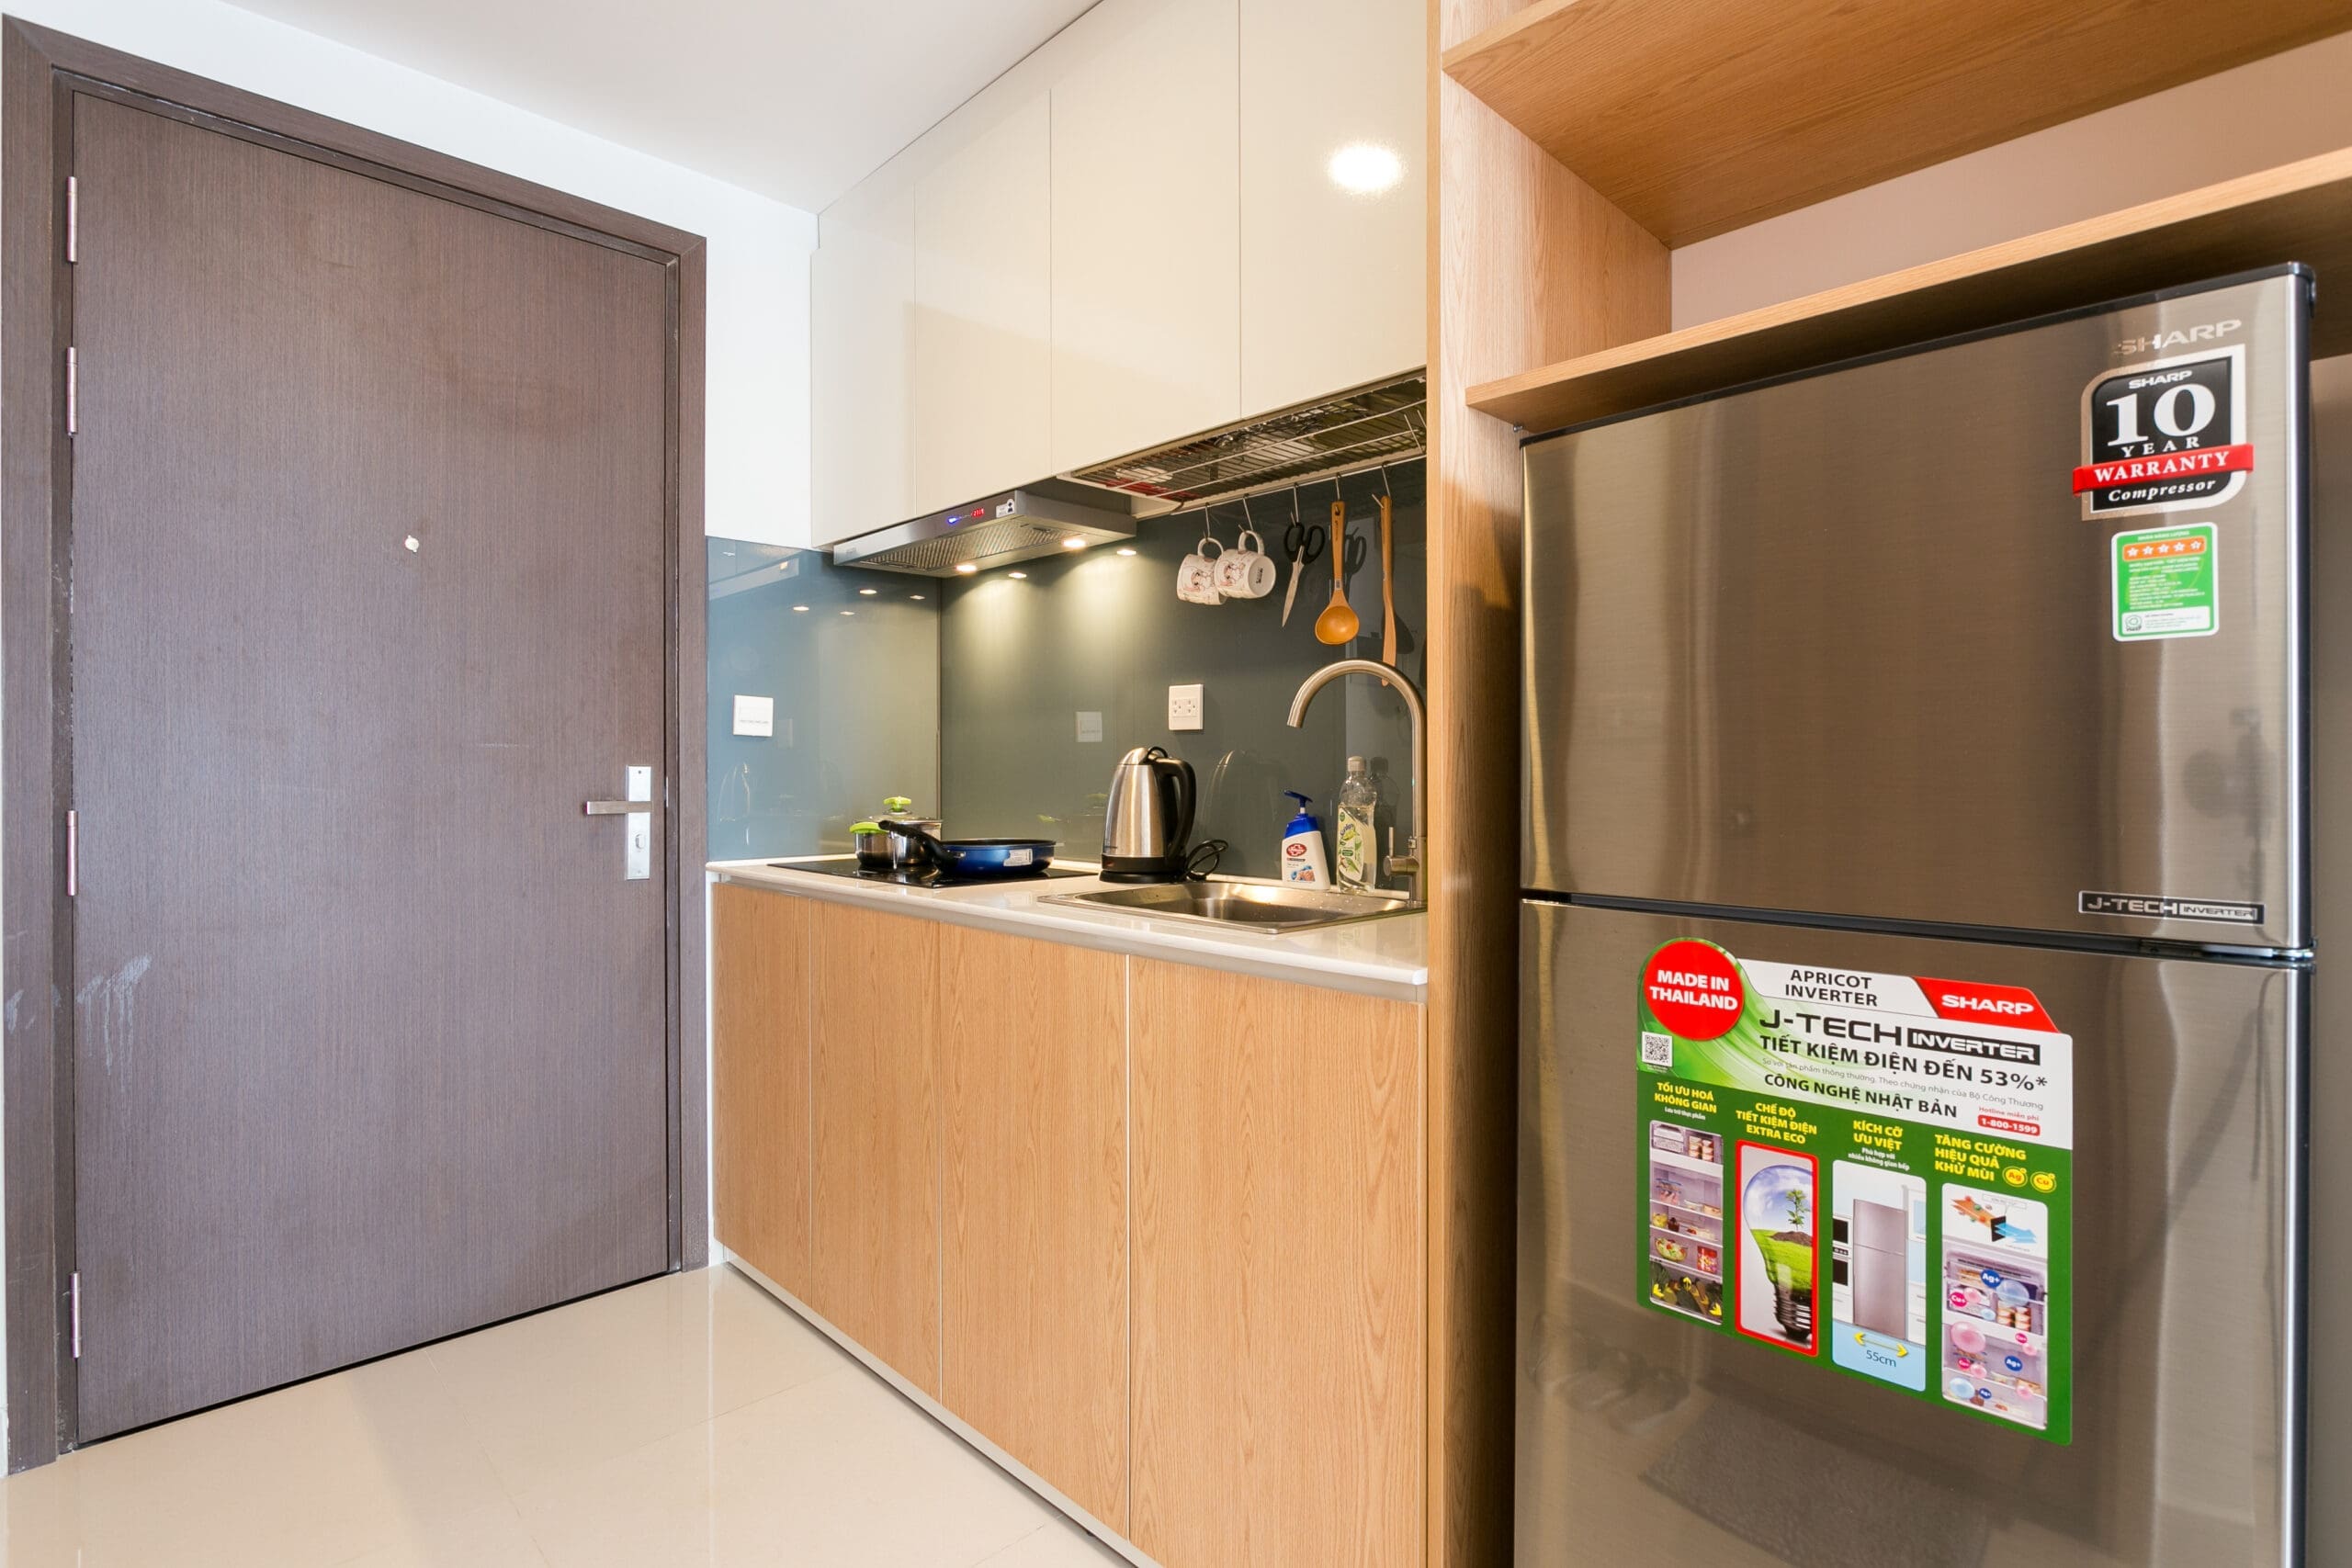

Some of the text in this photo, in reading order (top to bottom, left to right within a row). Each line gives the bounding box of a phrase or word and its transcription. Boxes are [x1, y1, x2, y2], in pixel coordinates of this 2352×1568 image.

[2114, 320, 2242, 355] SHARP
[2129, 370, 2192, 389] SHARP
[2107, 383, 2216, 446] 10
[2121, 436, 2199, 457] YEAR
[2095, 451, 2230, 483] WARRANTY
[2109, 479, 2216, 502] Compressor
[2087, 897, 2255, 918] J-TECH INVERTER
[1657, 970, 1729, 991] MADE IN
[1790, 969, 1872, 989] APRICOT
[1649, 987, 1738, 1010] THAILAND
[1785, 984, 1878, 1007] INVERTER
[1941, 994, 2034, 1015] SHARP
[1759, 1010, 2036, 1061] J-TECH INVERTER
[1759, 1034, 1802, 1055] TIẾT
[1807, 1043, 1858, 1065] KIỆM
[1864, 1051, 1917, 1075] ĐIỆN
[1924, 1058, 1973, 1081] ĐẾN
[1657, 1082, 1713, 1101] TỐI ƯU HOÁ
[1879, 1077, 1898, 1086] Theo
[1655, 1092, 1717, 1113] KHÔNG GIAN
[1764, 1073, 1957, 1118] CÔNG NGHỆ NHẬT BẢN
[1755, 1102, 1796, 1121] CHẾ ĐỘ
[1978, 1106, 2005, 1115] Hotline
[1736, 1110, 1817, 1135] TIẾT KIỆM ĐIỆN
[1853, 1120, 1883, 1134] KÍCH
[1981, 1117, 2038, 1134] 1-800-1599
[1747, 1123, 1806, 1145] EXTRA ECO
[1853, 1133, 1903, 1152] ƯU VIỆT
[1935, 1134, 2027, 1160] TĂNG CƯỜNG
[1935, 1147, 1999, 1168] HIỆU QUẢ
[1935, 1160, 1995, 1181] KHỬ MÙI
[1982, 1272, 2000, 1283] Ag+
[1866, 1349, 1897, 1368] 55cm
